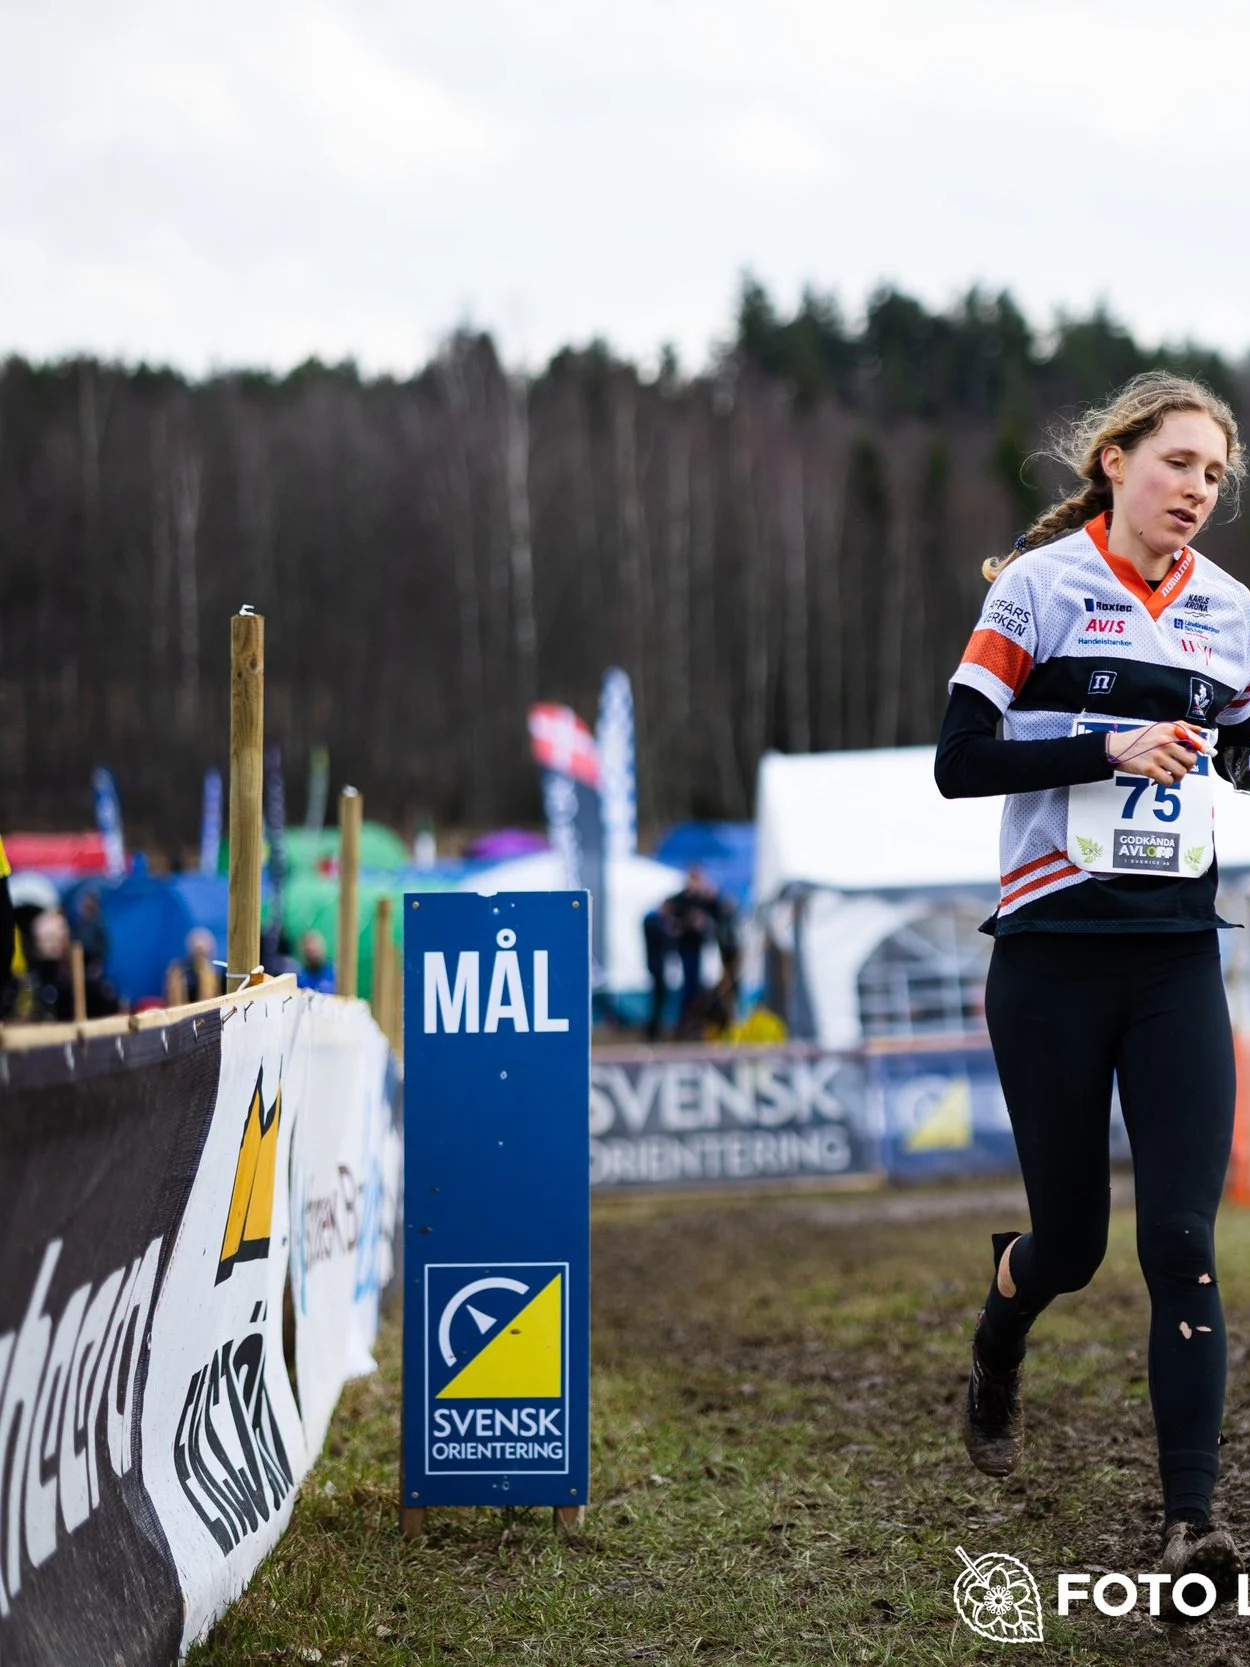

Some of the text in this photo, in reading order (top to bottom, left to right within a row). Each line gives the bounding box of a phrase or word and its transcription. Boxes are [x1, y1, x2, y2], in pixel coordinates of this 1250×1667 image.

[1160, 552, 1193, 598] noname
[1096, 601, 1132, 612] Roxtec
[1184, 601, 1209, 612] KRONA
[1189, 594, 1209, 605] KARLS
[1085, 618, 1125, 634] AVIS
[1078, 637, 1132, 647] Handelsbanken
[1115, 775, 1182, 822] 75
[1119, 835, 1175, 847] GODKÄNDA
[1118, 845, 1174, 859] AVLOPP
[424, 928, 569, 1034] MÅL
[590, 1057, 845, 1136] SVENSK
[433, 1408, 562, 1437] SVENSK
[432, 1441, 563, 1460] ORIENTERING
